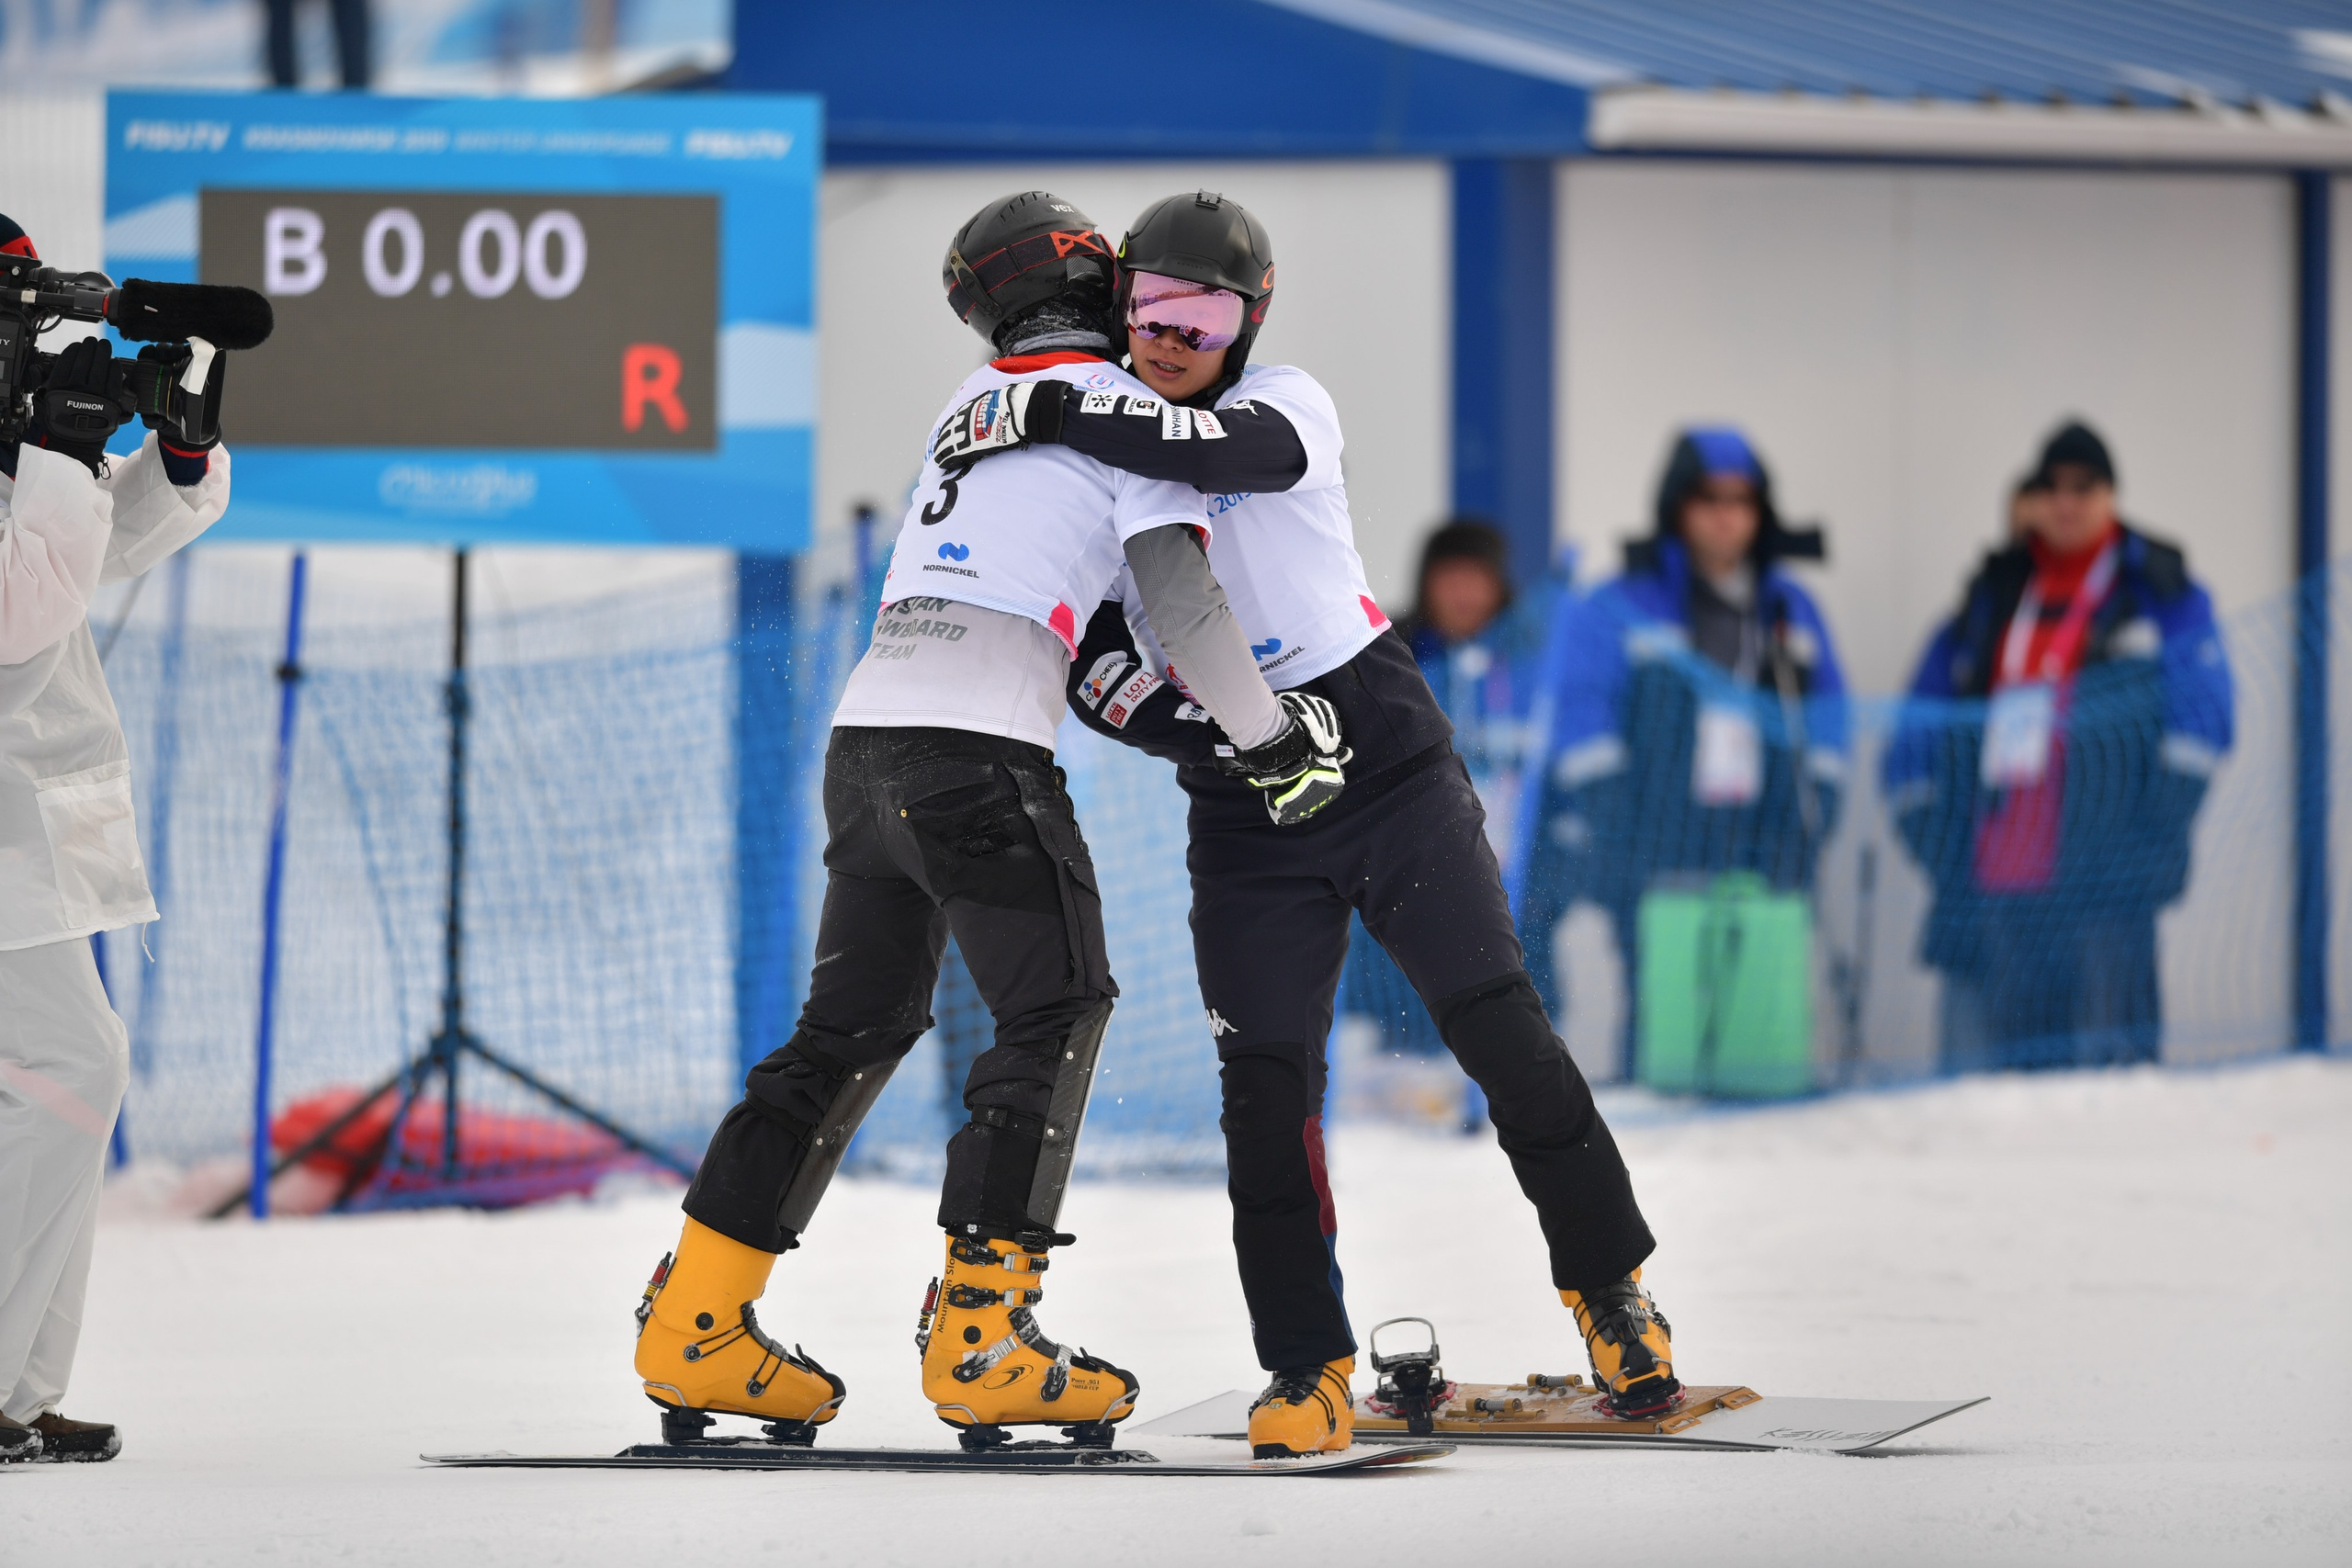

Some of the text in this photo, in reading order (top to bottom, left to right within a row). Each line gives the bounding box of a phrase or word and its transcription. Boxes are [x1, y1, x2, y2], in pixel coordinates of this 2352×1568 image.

[264, 207, 588, 300] B 0.00
[1172, 278, 1193, 287] OAKLEY
[621, 342, 691, 434] R
[66, 400, 105, 412] FUJINON
[1195, 409, 1216, 434] LOTTE
[922, 564, 980, 579] NORNICKEL
[866, 642, 917, 660] TEAM
[1258, 646, 1306, 673] RNICKEL
[1123, 671, 1154, 699] LOTT
[1130, 684, 1149, 703] DUTY
[937, 1257, 956, 1334] Mountain Slo
